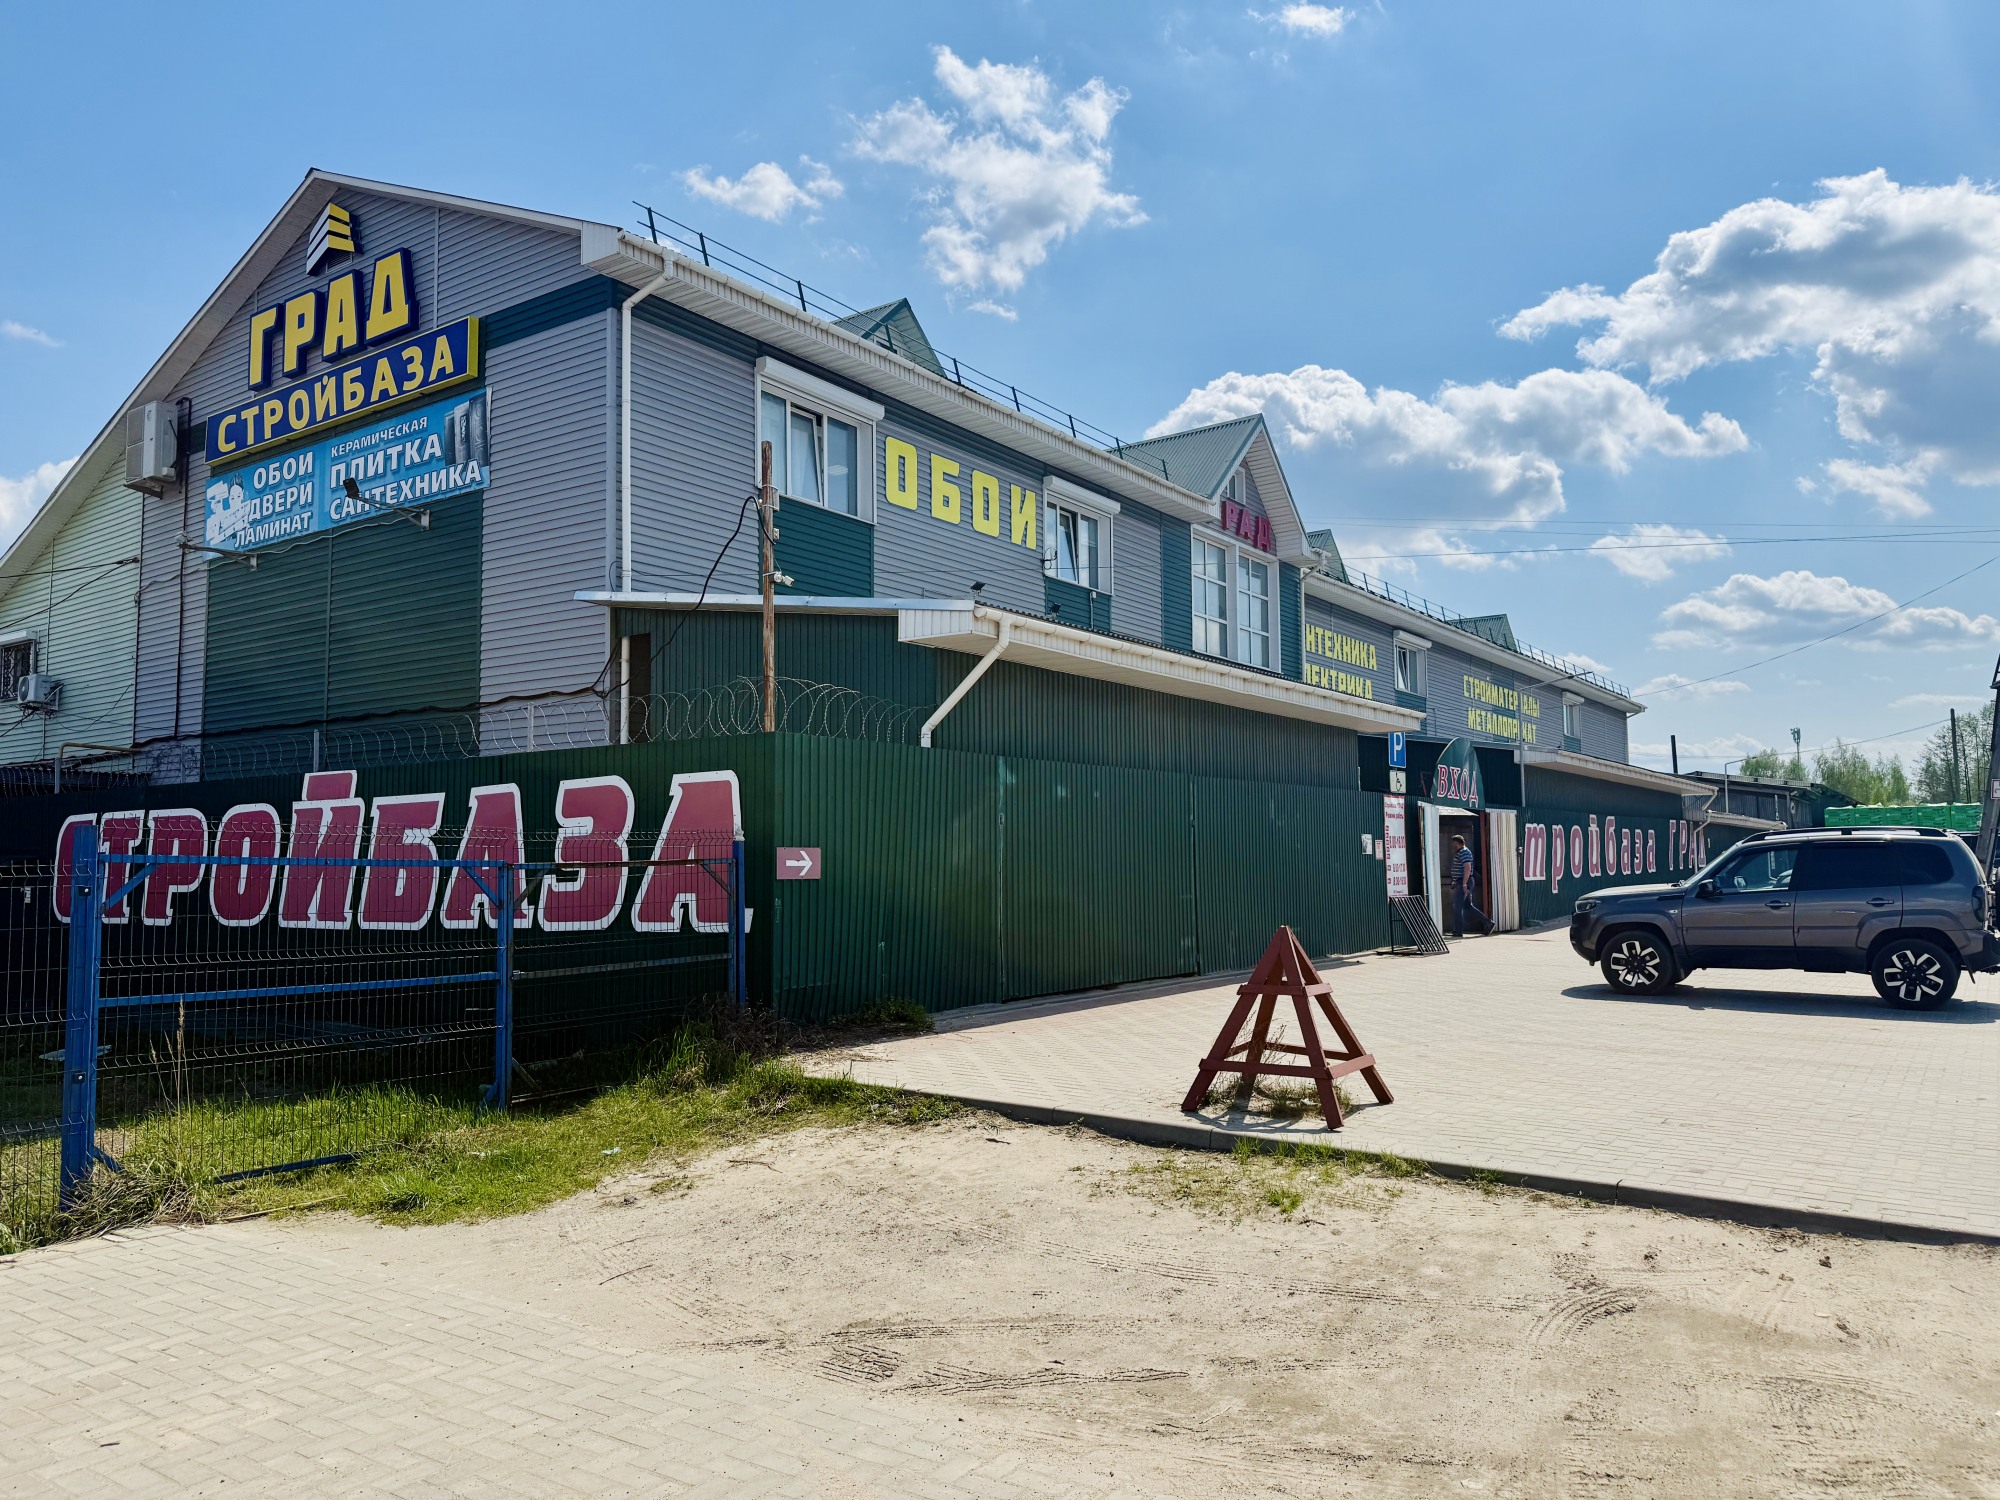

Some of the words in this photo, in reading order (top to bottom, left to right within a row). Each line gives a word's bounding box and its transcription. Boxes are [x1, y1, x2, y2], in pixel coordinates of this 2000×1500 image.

[248, 247, 418, 391] ГРАД
[217, 334, 454, 453] СТРОЙБАЗА
[330, 433, 443, 489] ПЛИТКА
[331, 416, 428, 458] КЕРАМИЧЕСКАЯ
[252, 451, 314, 490] ОБОИ
[329, 459, 482, 521] САНТЕХНИКА
[885, 436, 1037, 550] ОБОИ
[234, 511, 312, 548] ЛАМИНАТ
[248, 481, 313, 522] ДВЕРИ
[1437, 764, 1479, 808] ВХОД
[53, 769, 752, 933] СТРОЙБАЗА
